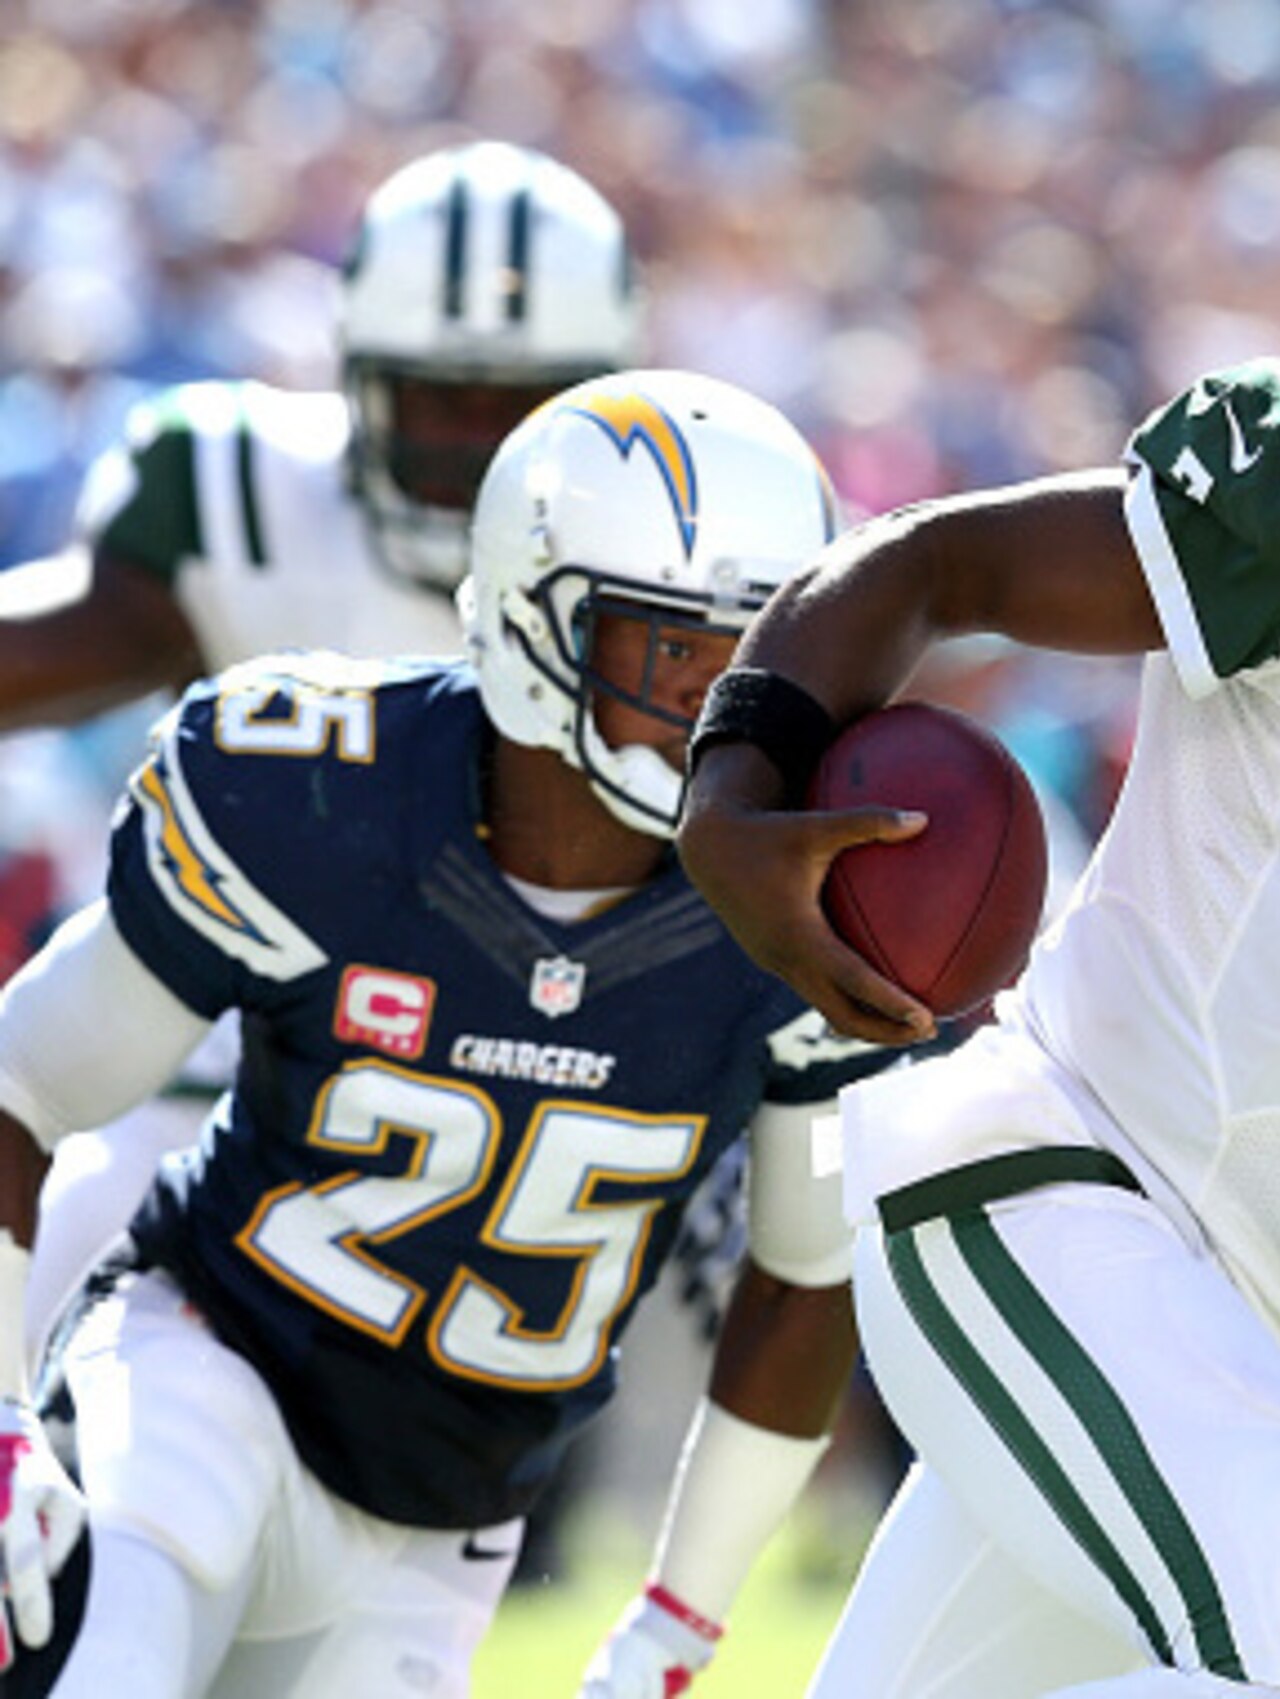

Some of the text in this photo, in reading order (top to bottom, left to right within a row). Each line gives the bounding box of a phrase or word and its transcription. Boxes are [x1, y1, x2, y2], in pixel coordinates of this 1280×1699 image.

[346, 974, 425, 1035] C
[450, 1034, 616, 1089] CHARGERS
[235, 1058, 709, 1393] 25
